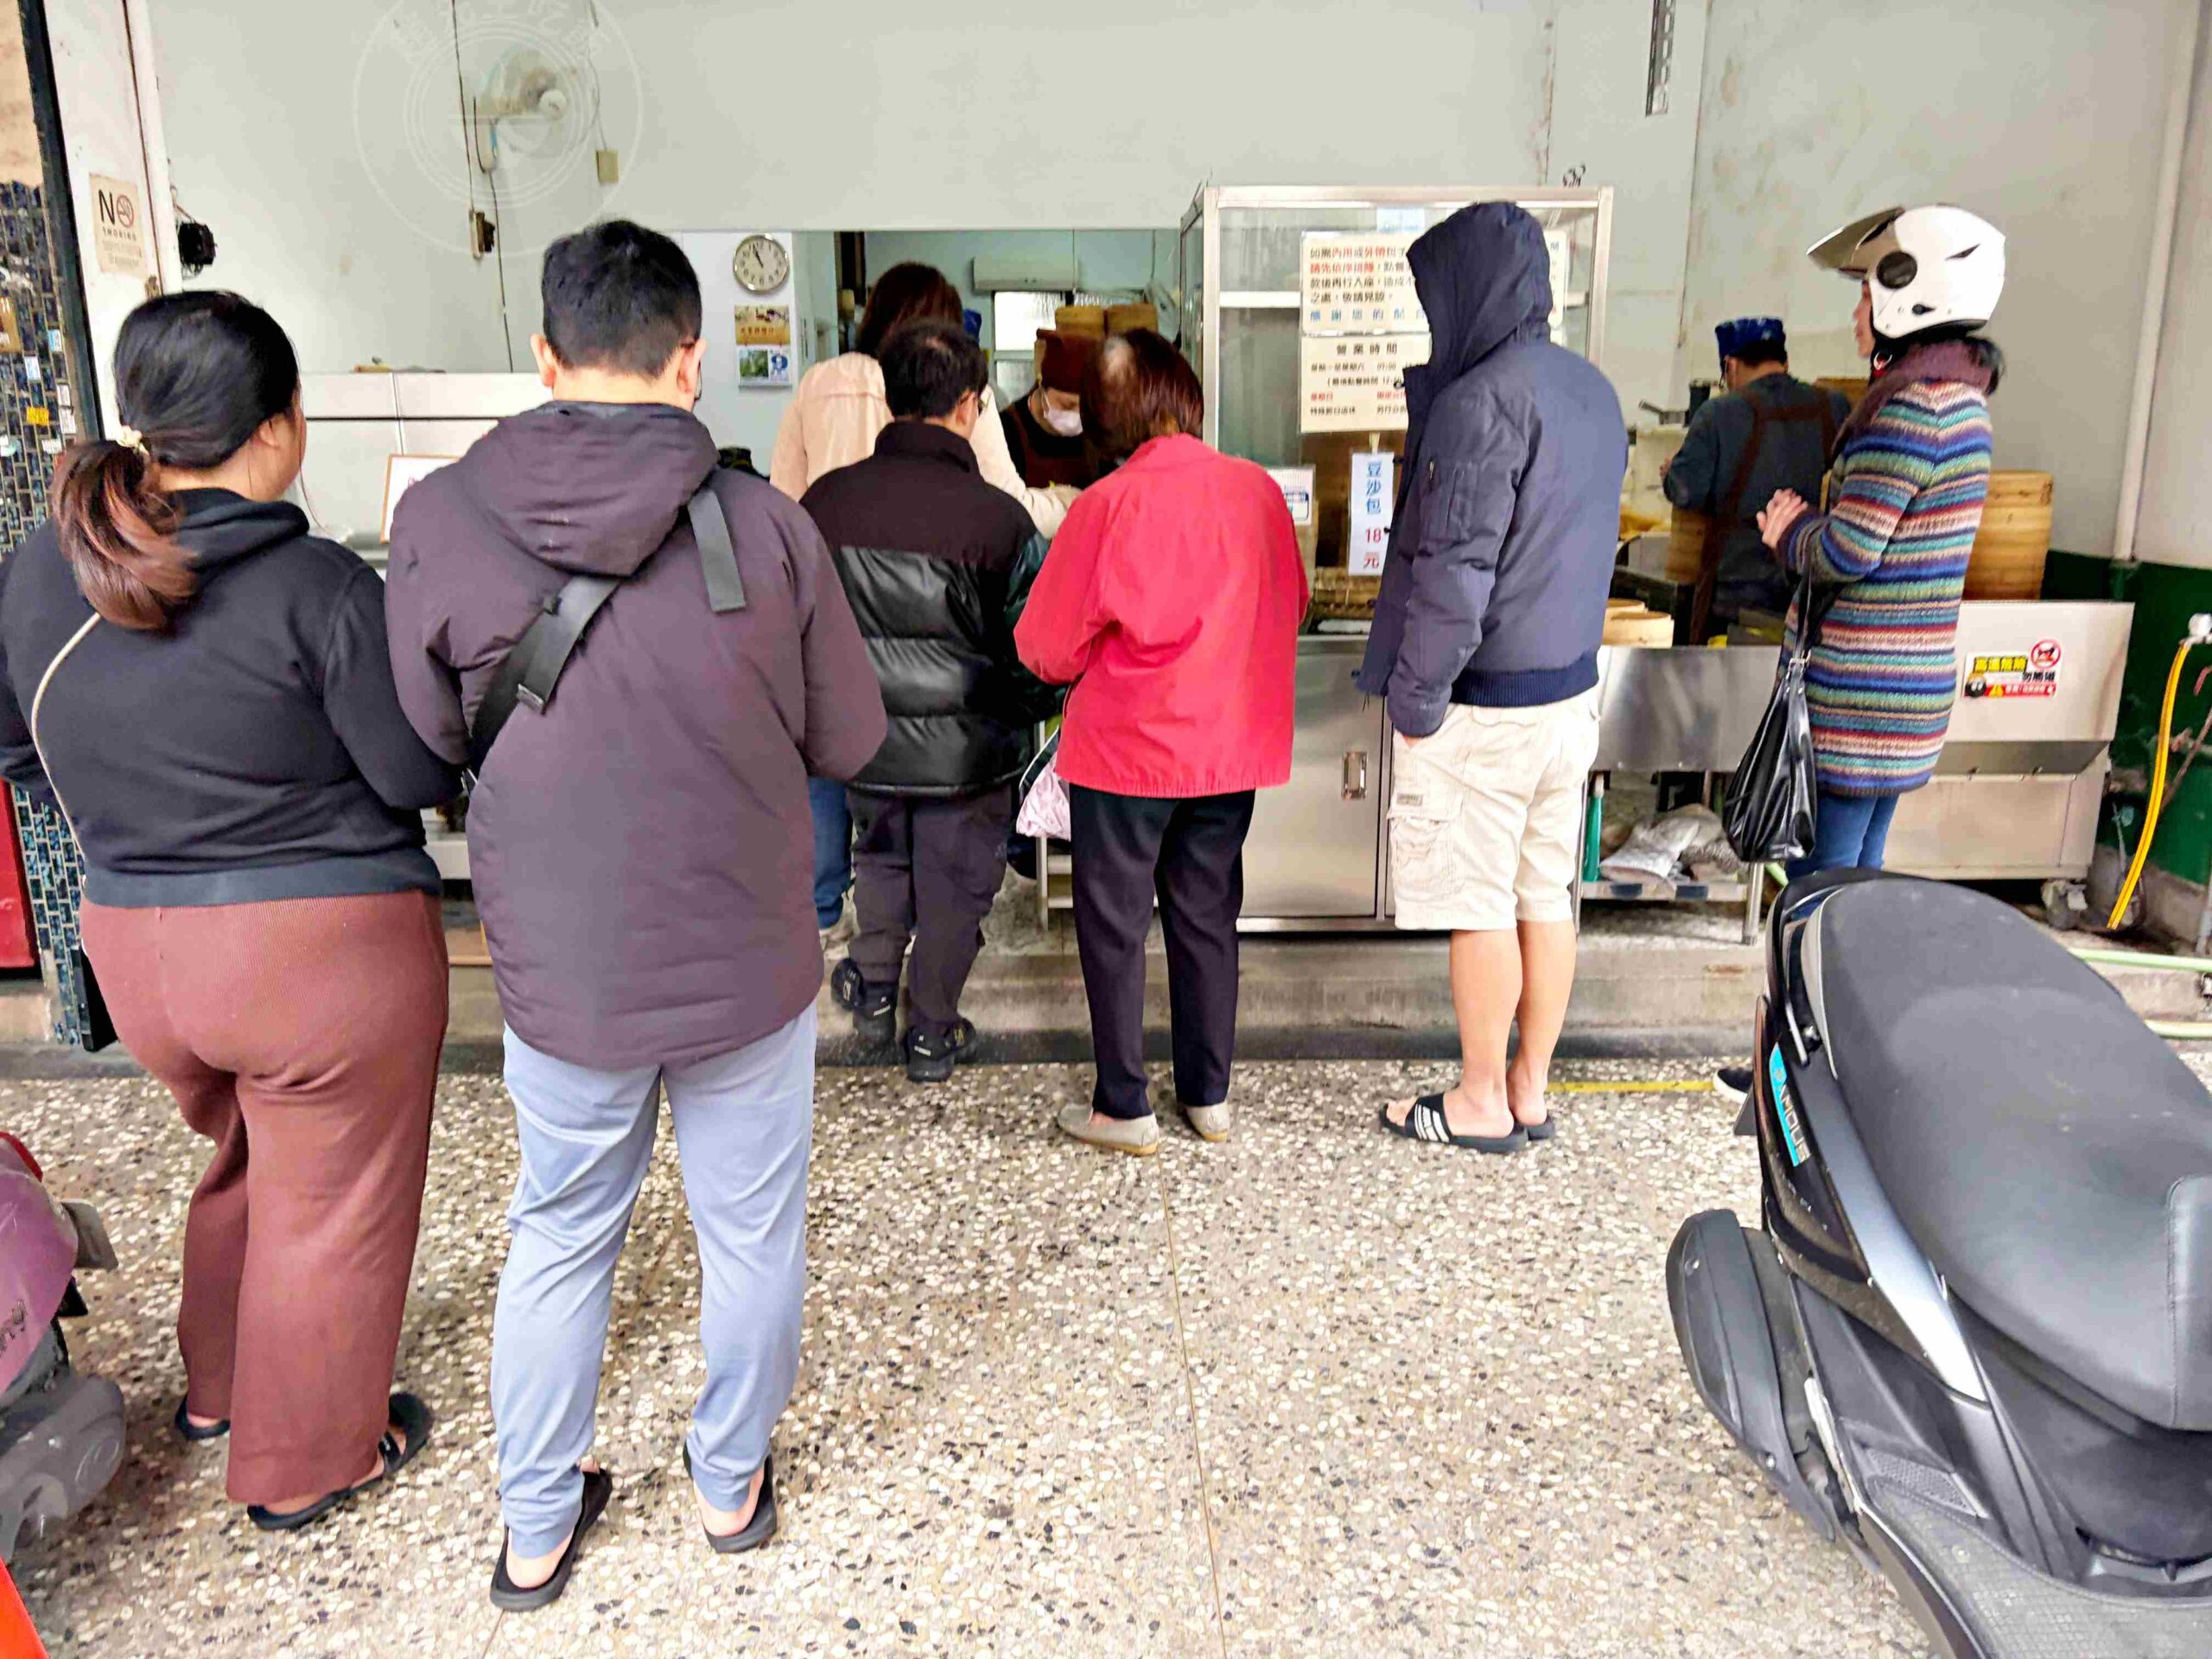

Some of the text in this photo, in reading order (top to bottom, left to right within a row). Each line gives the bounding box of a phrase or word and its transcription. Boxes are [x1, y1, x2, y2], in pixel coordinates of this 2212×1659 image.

[102, 226, 137, 241] SMOKING
[1363, 461, 1382, 569] 豆沙包 18 元
